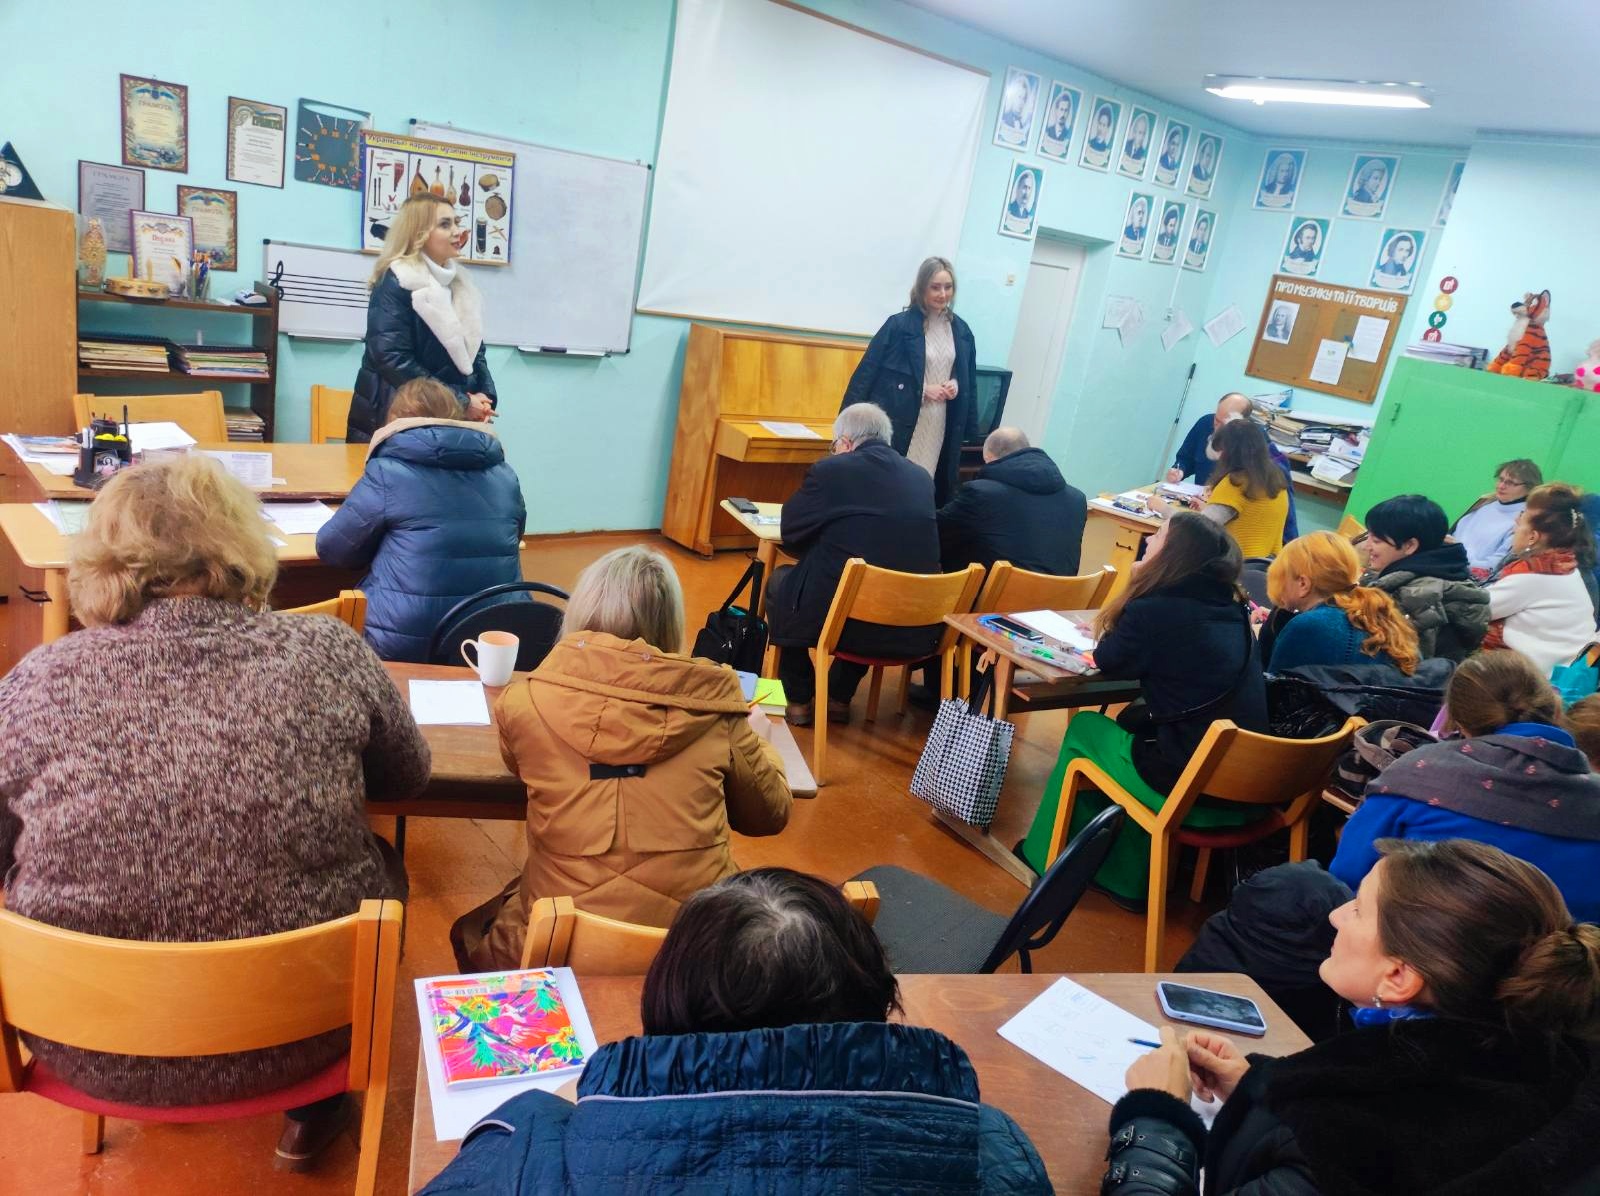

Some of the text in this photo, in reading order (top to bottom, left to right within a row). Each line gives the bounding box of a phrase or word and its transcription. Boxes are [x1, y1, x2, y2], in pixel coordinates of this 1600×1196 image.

[1275, 281, 1398, 313] ПРО МУЗИКУ ТА ЇЇ ТВОРЦІВ
